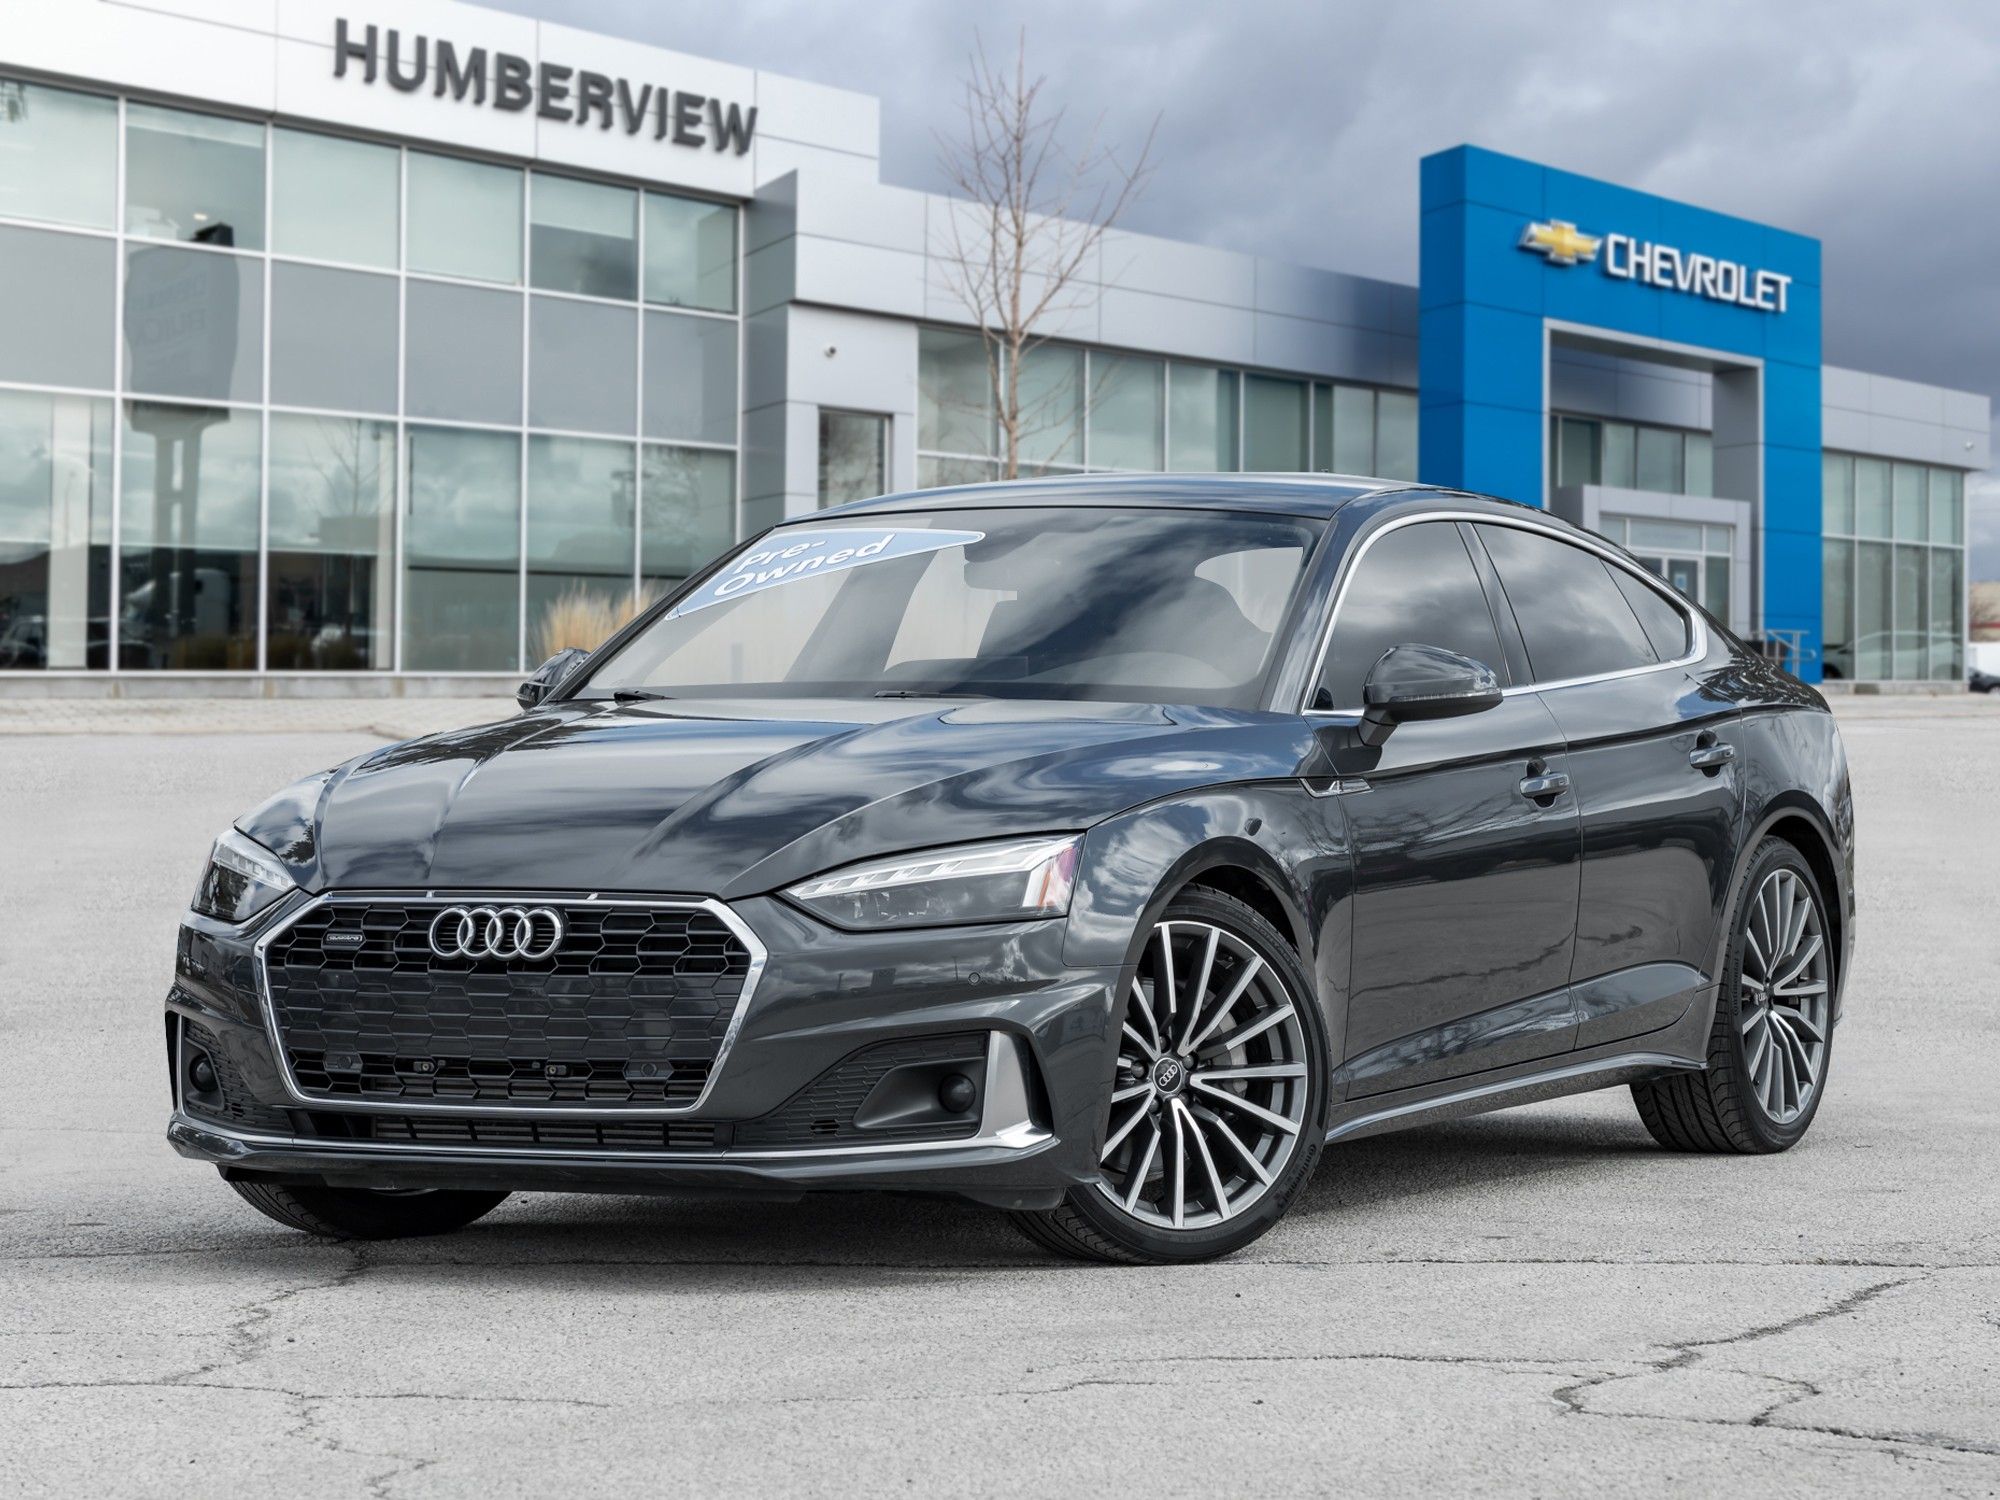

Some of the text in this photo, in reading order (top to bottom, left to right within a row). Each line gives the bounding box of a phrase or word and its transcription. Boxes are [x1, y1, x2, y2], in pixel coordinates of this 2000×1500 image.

[334, 18, 758, 156] HUMBERVIEW
[1606, 232, 1792, 313] CHEVROLET
[714, 532, 896, 596] Owned
